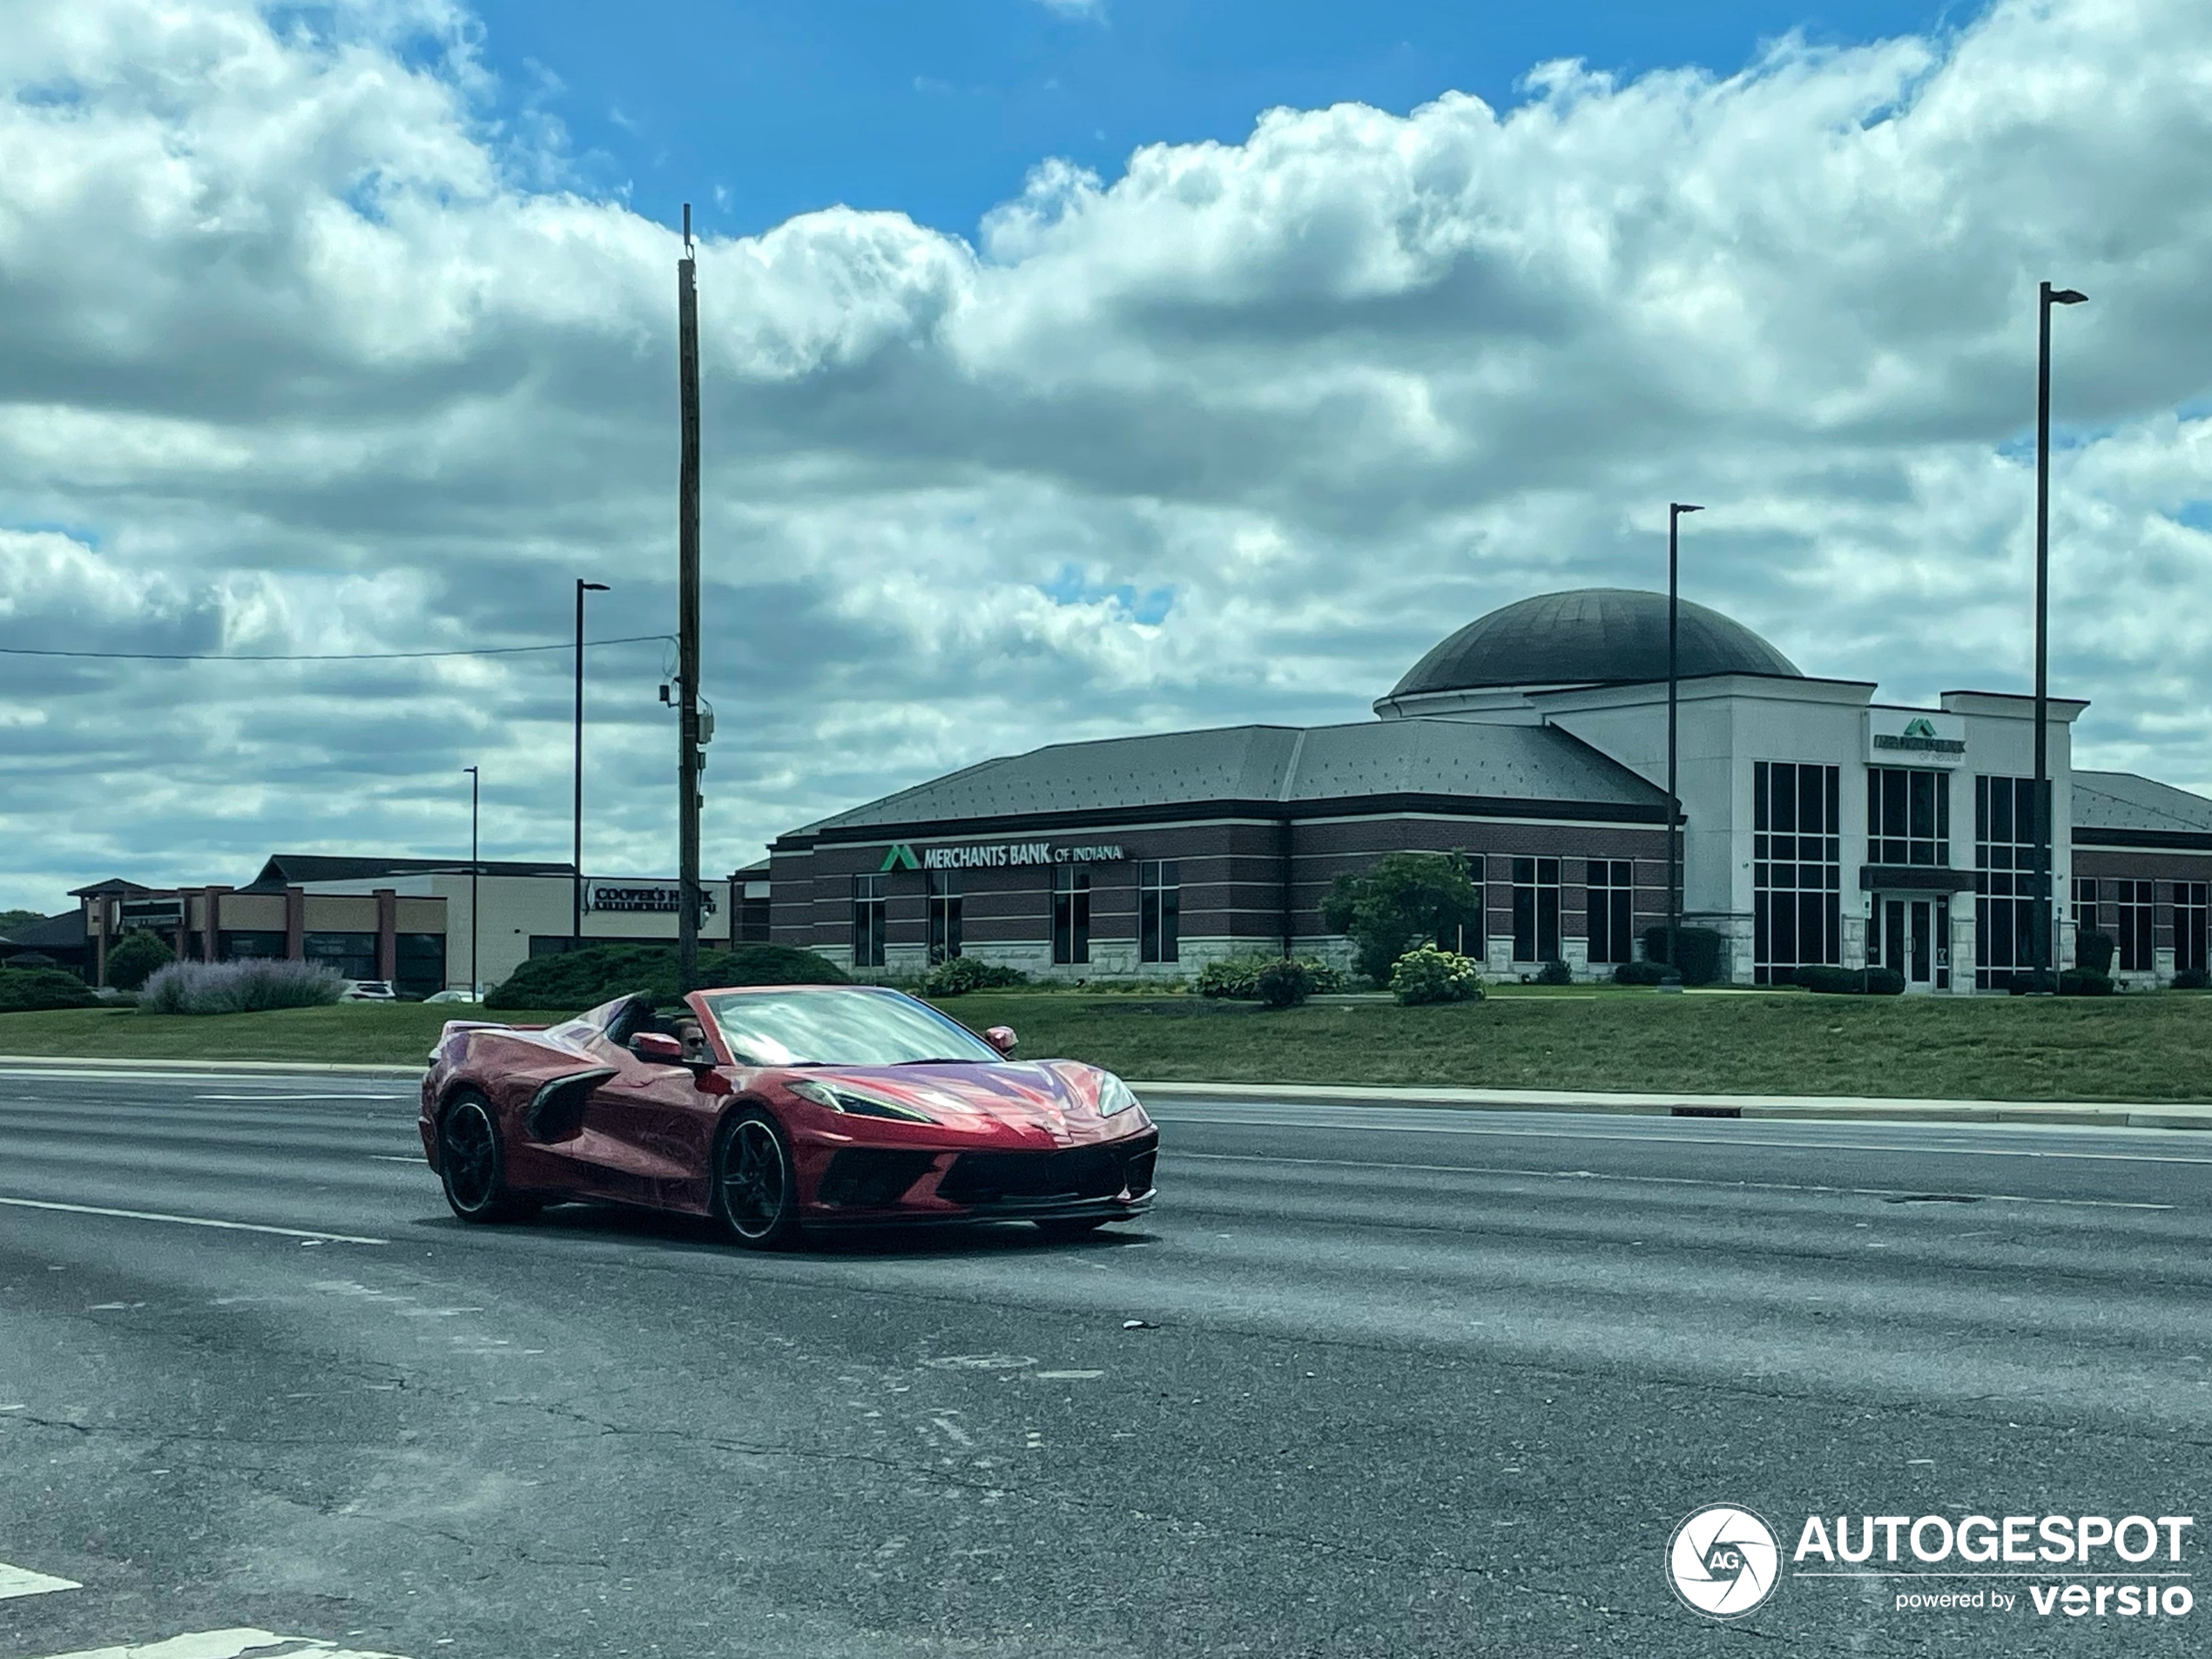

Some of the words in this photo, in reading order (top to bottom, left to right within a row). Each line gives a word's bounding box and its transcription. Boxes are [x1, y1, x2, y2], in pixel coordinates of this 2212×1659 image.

[924, 846, 1007, 869] MERCHANTS
[1010, 843, 1053, 865] BANK
[1055, 848, 1071, 862] OF
[1073, 845, 1124, 861] INDIANA
[669, 889, 713, 902] HK
